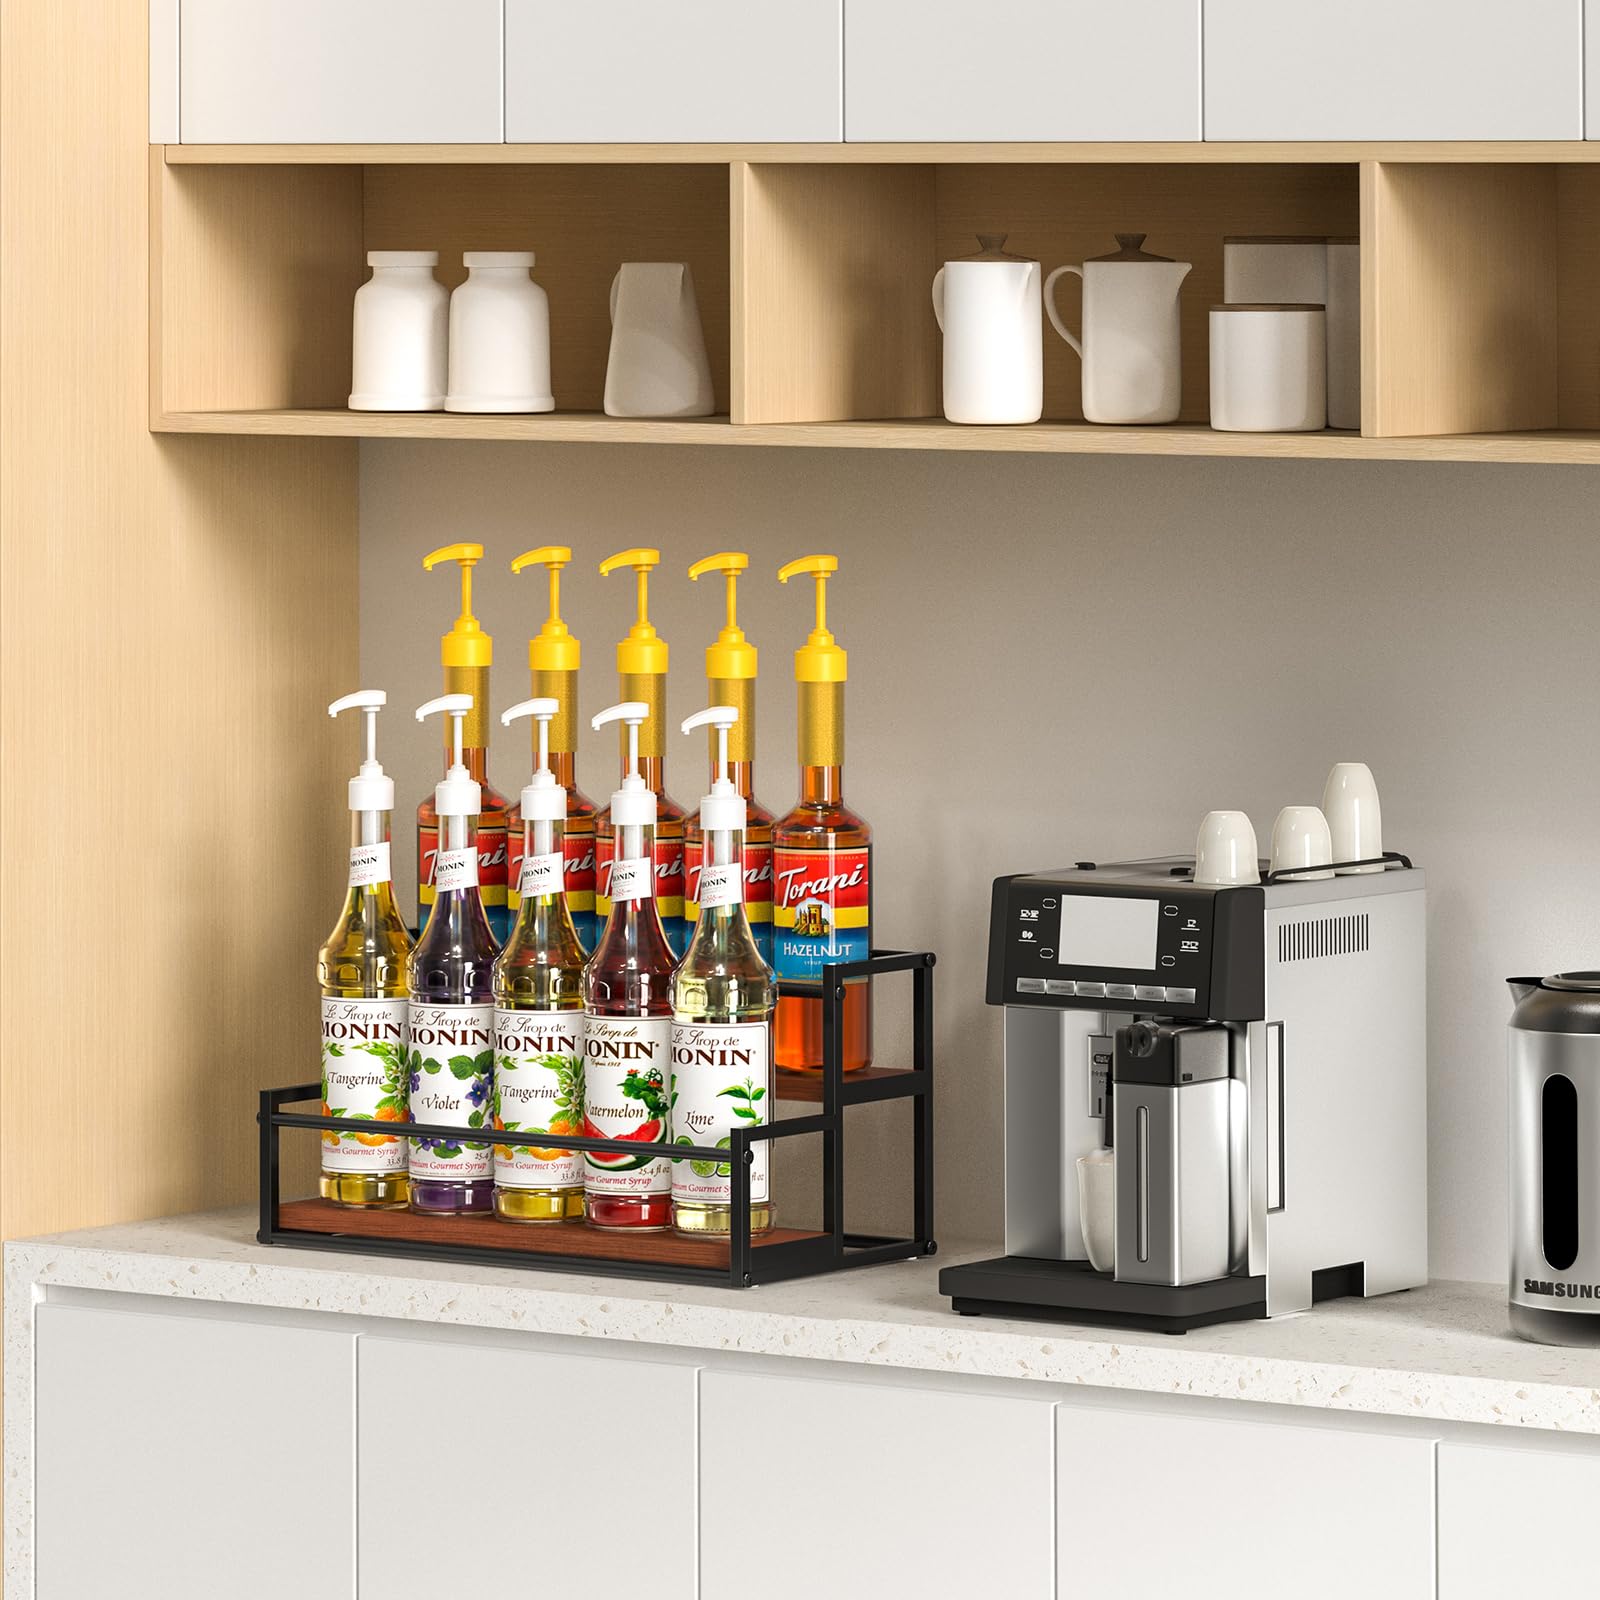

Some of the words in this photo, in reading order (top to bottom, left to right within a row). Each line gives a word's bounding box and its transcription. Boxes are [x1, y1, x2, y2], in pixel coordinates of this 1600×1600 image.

[350, 856, 378, 868] MONIN
[778, 863, 865, 910] Torani
[783, 942, 852, 957] HAZELNUT
[324, 1003, 338, 1019] Le
[339, 1004, 374, 1024] Sirop
[377, 1011, 392, 1020] de
[411, 1010, 425, 1025] Le
[426, 1010, 461, 1030] Sirop
[465, 1017, 480, 1026] de
[497, 1016, 511, 1031] Le
[512, 1017, 547, 1037] Sirop
[551, 1024, 566, 1033] de
[593, 1023, 622, 1041] Sirop
[623, 1026, 638, 1037] de
[672, 1029, 684, 1044] Le
[685, 1029, 719, 1050] Sirop
[724, 1037, 740, 1047] de
[326, 1071, 386, 1090] Tangerine
[421, 1093, 460, 1111] Violet
[500, 1085, 560, 1104] Tangerine
[684, 1110, 715, 1134] Lime
[341, 1147, 375, 1156] Gourmet
[377, 1147, 400, 1159] Syrup
[430, 1162, 463, 1170] Gourmet
[464, 1162, 487, 1173] Syrup
[515, 1161, 549, 1170] Gourmet
[550, 1161, 573, 1173] Syrup
[638, 1167, 654, 1176] 25.4
[653, 1164, 662, 1177] fl
[662, 1166, 670, 1174] oz
[595, 1175, 627, 1185] Gourmet
[628, 1176, 652, 1188] Syrup
[688, 1184, 722, 1193] Gourmet
